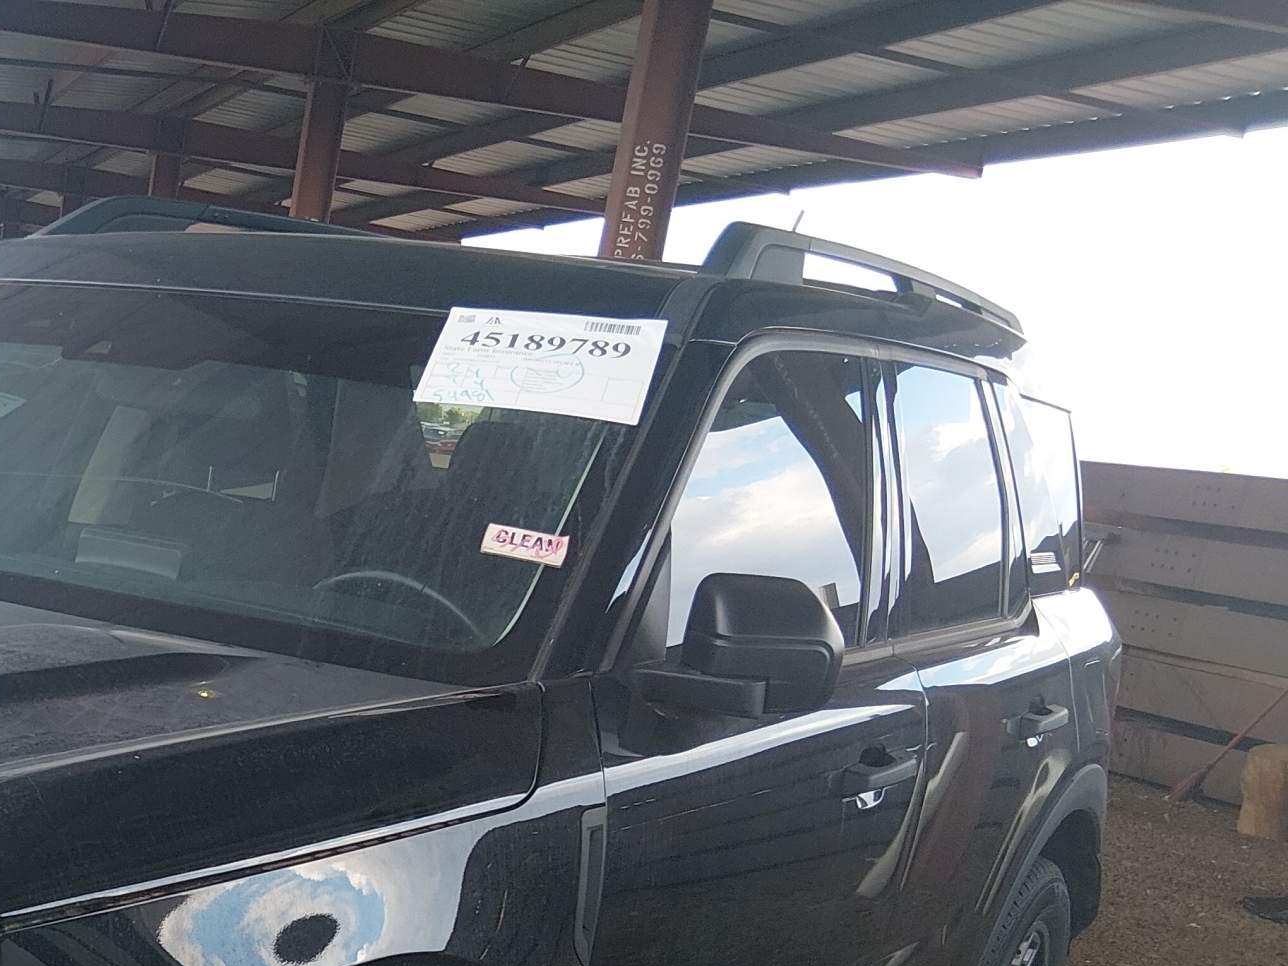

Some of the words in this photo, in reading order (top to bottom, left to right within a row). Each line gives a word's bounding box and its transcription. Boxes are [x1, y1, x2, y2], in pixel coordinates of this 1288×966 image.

[614, 186, 640, 259] PREFAB
[630, 140, 651, 176] INC.
[461, 330, 631, 359] 45189789
[495, 530, 561, 552] CLEAN
